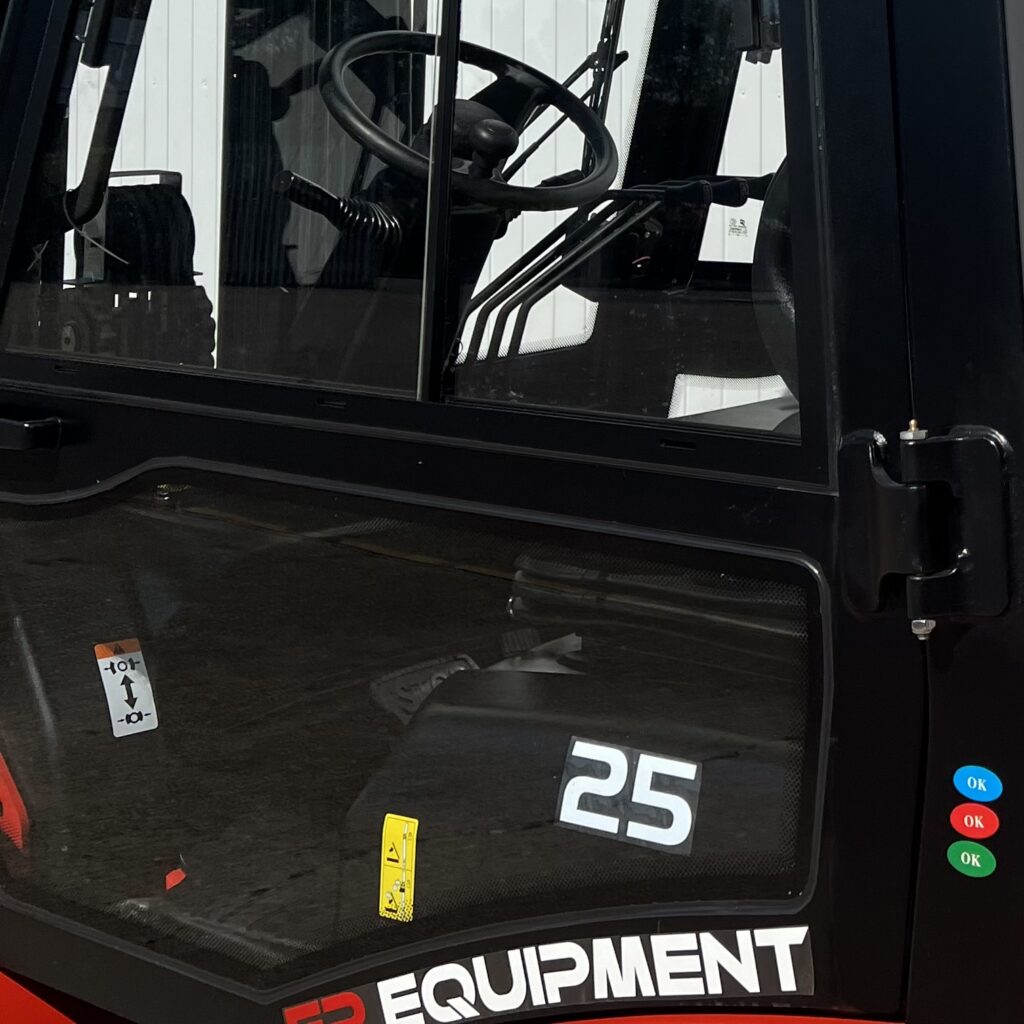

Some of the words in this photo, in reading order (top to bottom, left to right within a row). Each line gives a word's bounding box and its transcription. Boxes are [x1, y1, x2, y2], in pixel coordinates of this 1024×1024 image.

[967, 776, 987, 792] OK
[559, 740, 698, 846] 25
[963, 814, 984, 829] OK
[960, 851, 981, 867] OK
[377, 926, 809, 1024] EQUIPMENT
